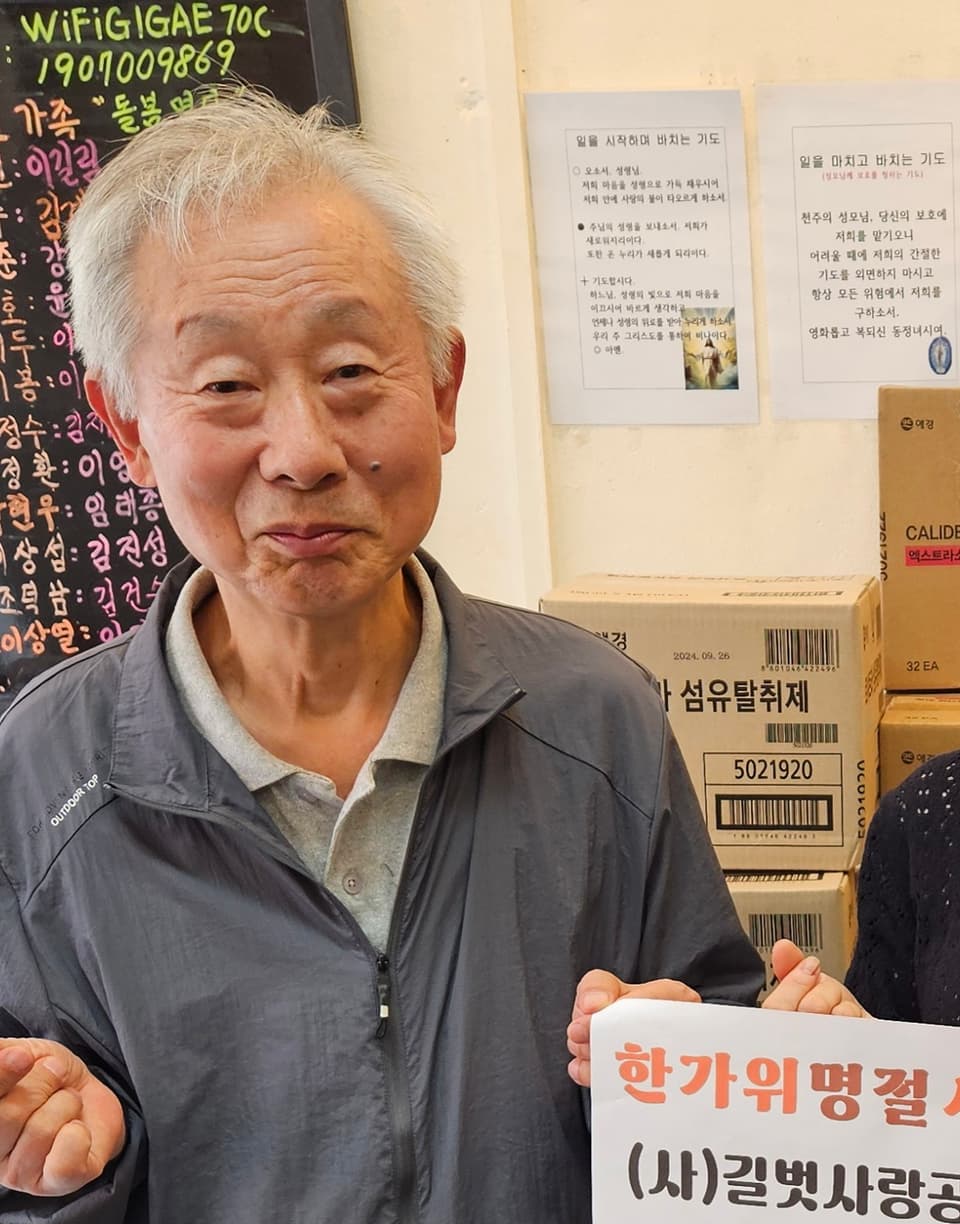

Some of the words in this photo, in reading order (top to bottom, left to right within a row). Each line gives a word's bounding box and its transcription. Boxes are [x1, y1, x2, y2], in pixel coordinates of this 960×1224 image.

[37, 39, 236, 87] 1907009869
[14, 97, 80, 140] 가족
[576, 135, 598, 148] 일을
[606, 135, 650, 148] 시작하며
[656, 134, 691, 146] 바치는
[697, 133, 721, 145] 기도
[800, 155, 824, 169] 일을
[831, 154, 868, 168] 마치고
[876, 153, 913, 167] 바치는
[920, 152, 946, 166] 기도
[801, 212, 832, 224] 천주의
[878, 210, 910, 223] 당신의
[915, 209, 947, 221] 보호에
[835, 230, 867, 243] 저희를
[810, 250, 841, 262] 어려울
[873, 249, 904, 261] 저희의
[818, 269, 850, 281] 기도를
[855, 268, 897, 281] 외면하지
[902, 267, 934, 280] 마시고
[812, 288, 832, 301] 항상
[838, 288, 858, 300] 모든
[864, 287, 905, 300] 위험에서
[911, 286, 942, 299] 저희를
[809, 327, 850, 340] 영화롭고
[856, 326, 886, 338] 복되신
[915, 418, 935, 430] 애경
[906, 661, 920, 673] 32
[923, 660, 939, 672] EA
[680, 679, 808, 713] 섬유탈취제
[734, 759, 813, 780] 5021920
